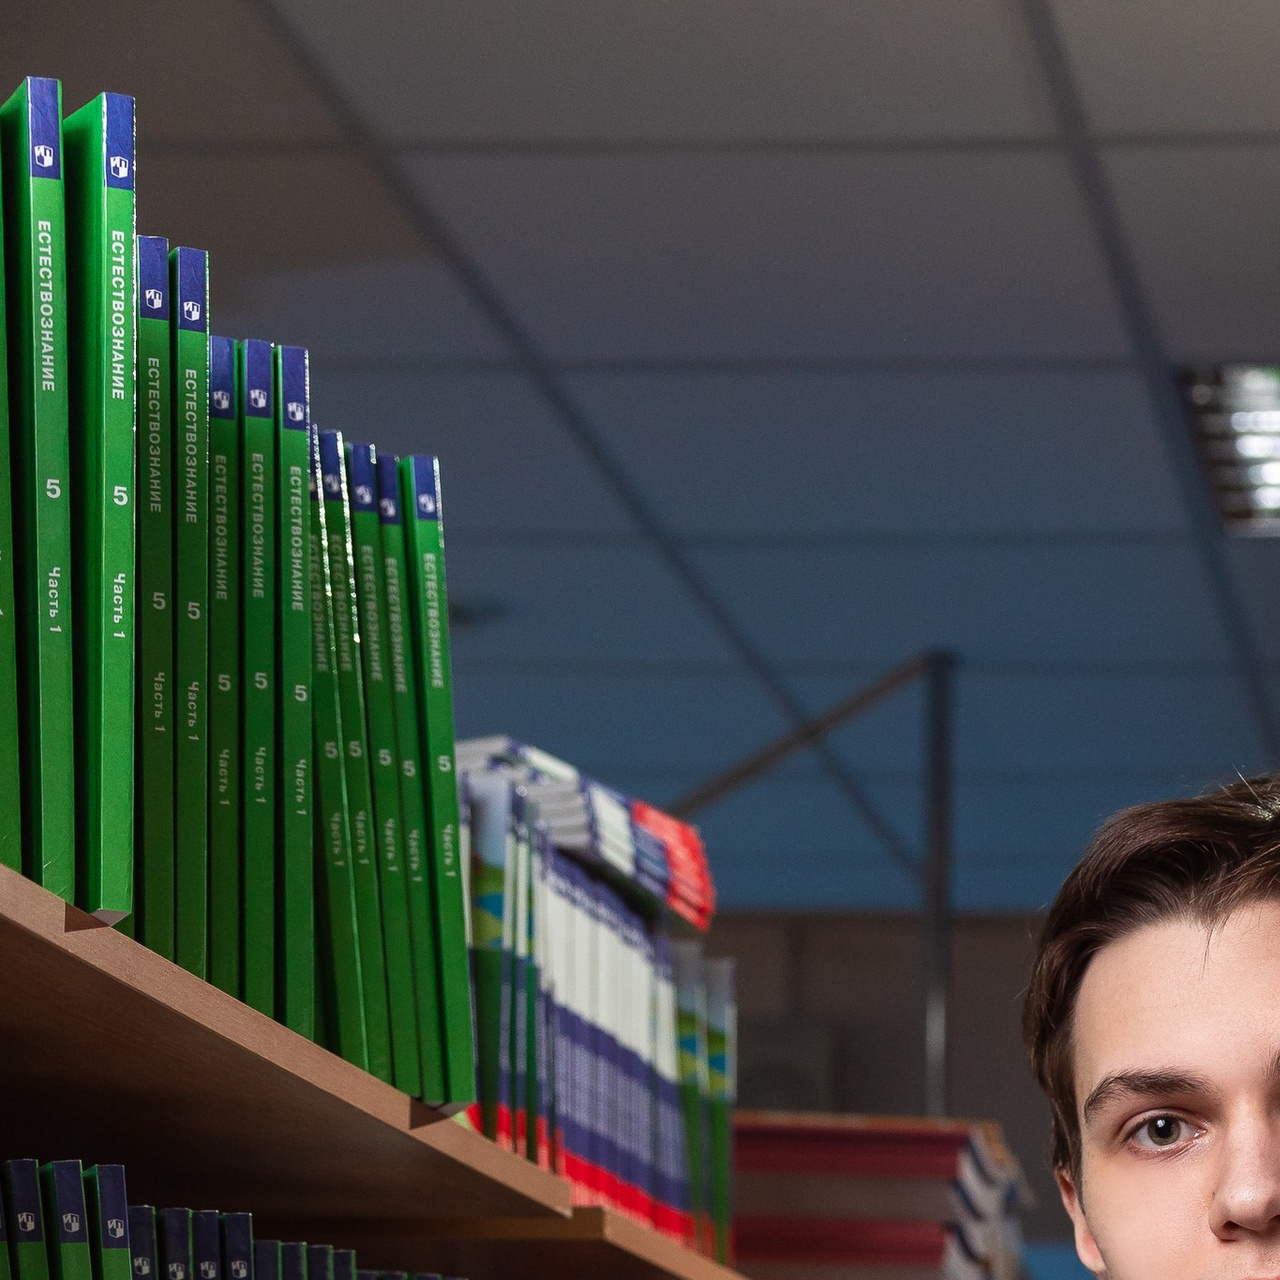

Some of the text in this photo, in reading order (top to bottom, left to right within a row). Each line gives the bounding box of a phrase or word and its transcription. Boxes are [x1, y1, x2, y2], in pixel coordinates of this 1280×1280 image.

[38, 220, 55, 392] ЕСТЕСТВОЗНАНИЕ
[110, 229, 125, 400] ЕСТЕСТВОЗНАНИЕ
[148, 357, 161, 513] ЕСТЕСТВОЗНАНИЕ
[185, 369, 197, 524] ЕСТЕСТВОЗНАНИЕ
[46, 478, 61, 499] 5
[113, 486, 128, 506] 5
[214, 455, 228, 601] ЕСТЕСТВОЗНАНИЕ
[252, 453, 265, 599] ЕСТЕСТВОЗНАНИЕ
[289, 466, 304, 612] ЕСТЕСТВОЗНАНИЕ
[48, 566, 61, 618] Часть
[113, 573, 126, 639] Часть 1
[153, 592, 166, 610] 5
[187, 601, 201, 620] 5
[330, 534, 352, 672] ЕСТЕСТВОЗНАНИЕ
[361, 545, 383, 682] ЕСТЕСТВОЗНАНИЕ
[385, 557, 407, 693] ЕСТЕСТВОЗНАНИЕ
[423, 553, 444, 688] ЕСТЕСТВОЗНАНИЕ
[154, 672, 165, 719] Часть
[218, 673, 231, 692] 5
[254, 672, 268, 690] 5
[294, 684, 308, 702] 5
[187, 681, 199, 728] Часть
[219, 749, 230, 793] Часть
[254, 746, 266, 791] Часть
[324, 742, 338, 759] 5
[350, 741, 362, 758] 5
[378, 749, 392, 766] 5
[403, 760, 416, 778] 5
[438, 755, 451, 773] 5
[294, 758, 306, 803] Часть
